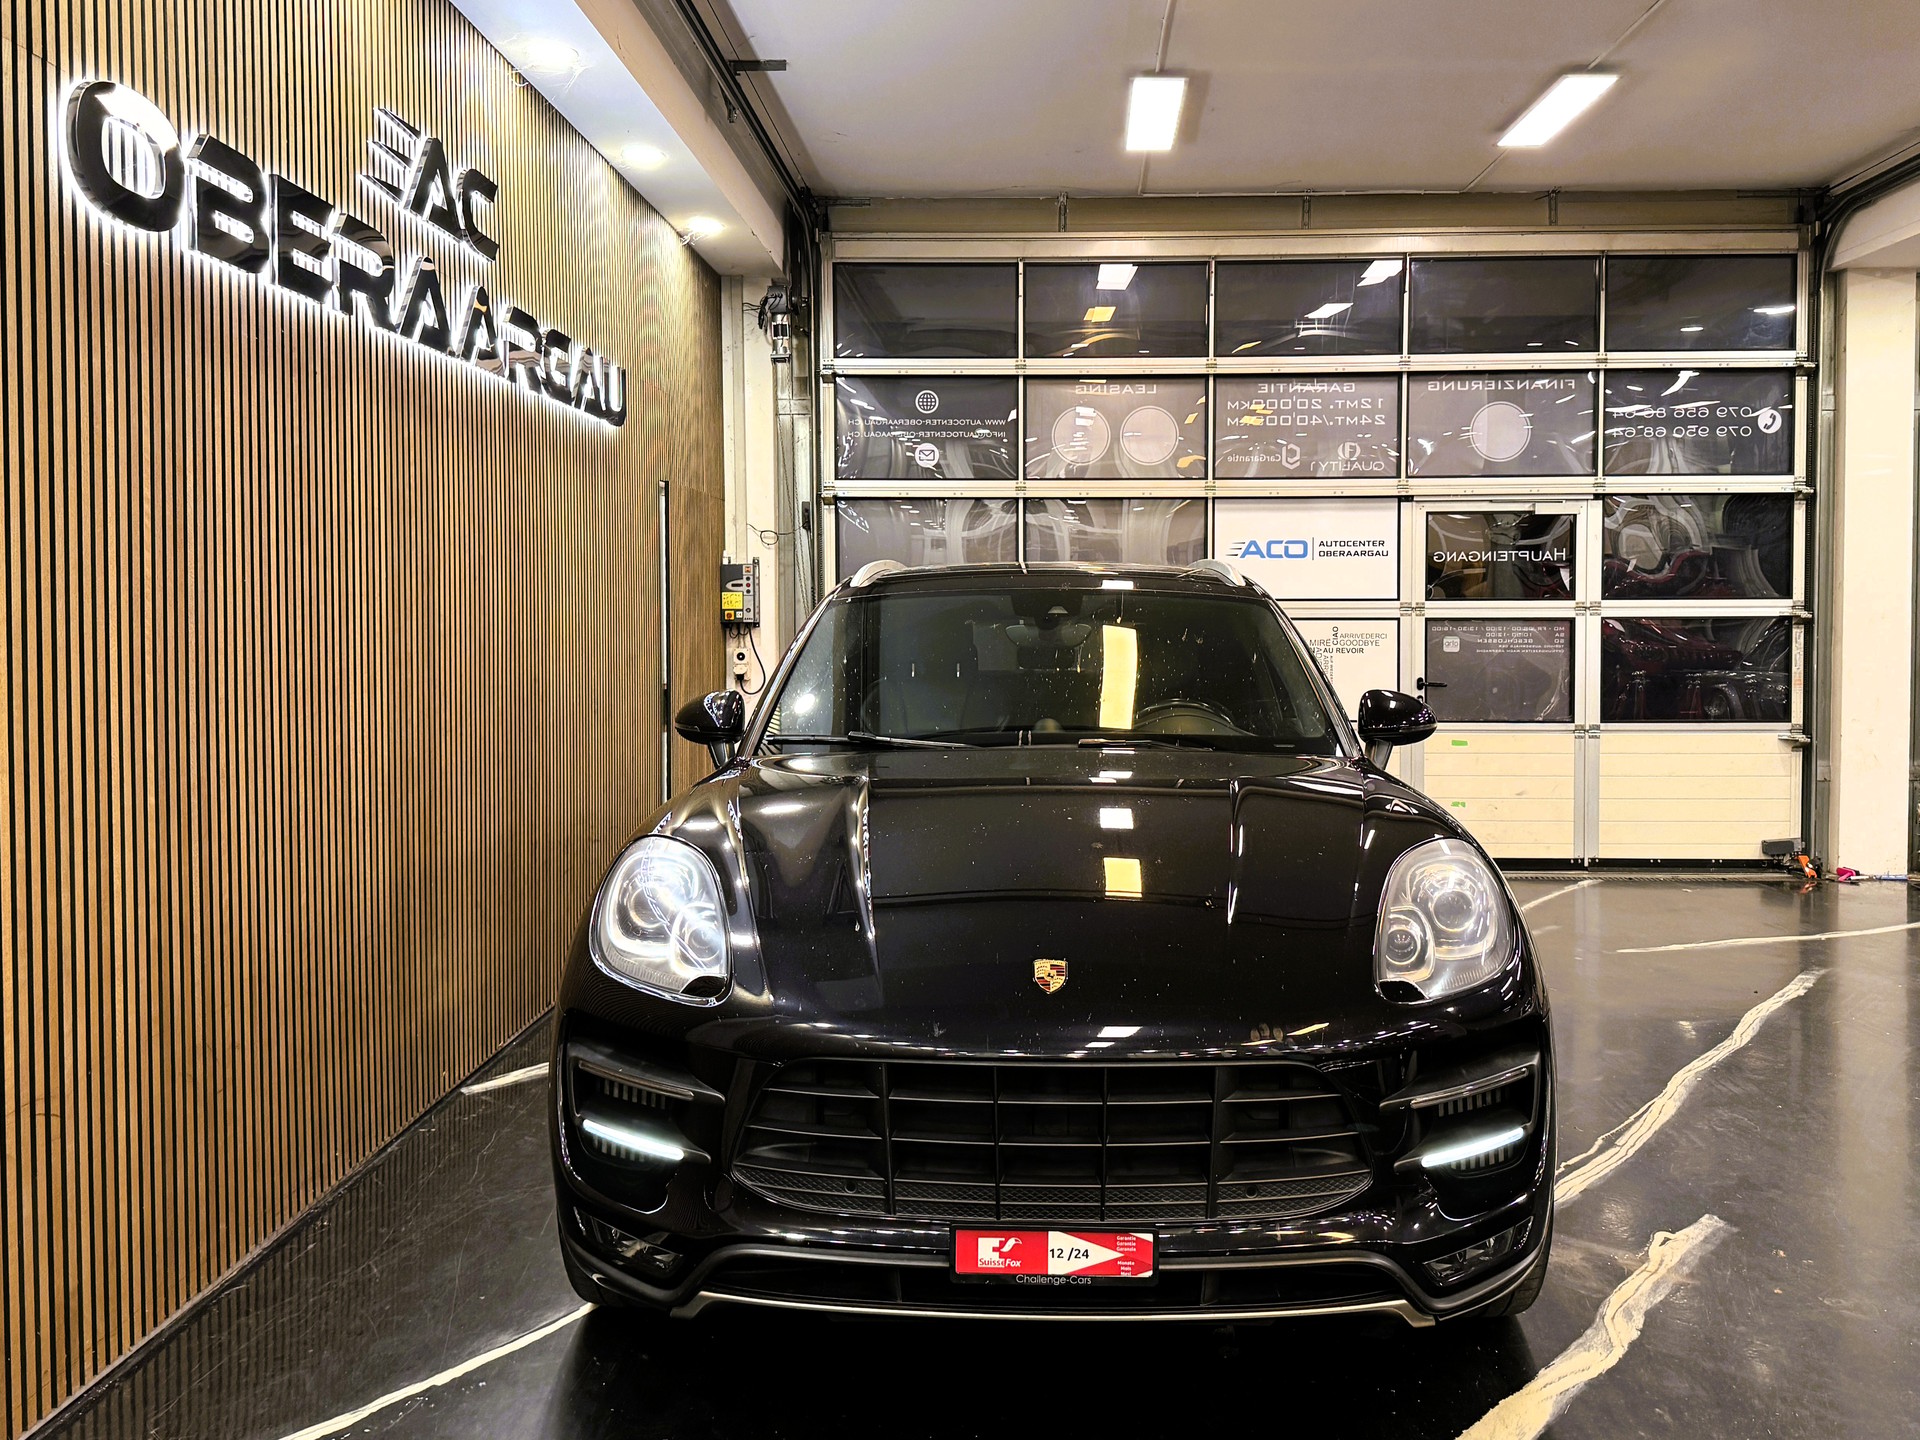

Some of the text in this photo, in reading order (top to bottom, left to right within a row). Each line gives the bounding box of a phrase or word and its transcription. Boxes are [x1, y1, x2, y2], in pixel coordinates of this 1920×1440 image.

[65, 79, 626, 427] OBERAARGAU
[1240, 539, 1308, 559] ACO
[1318, 540, 1385, 548] AUTOCENTER
[1318, 550, 1389, 558] OBERAARGAU
[1339, 639, 1380, 647] GOODBYE
[1049, 1248, 1064, 1259] 12
[1015, 1274, 1092, 1285] Challenge-Cars
